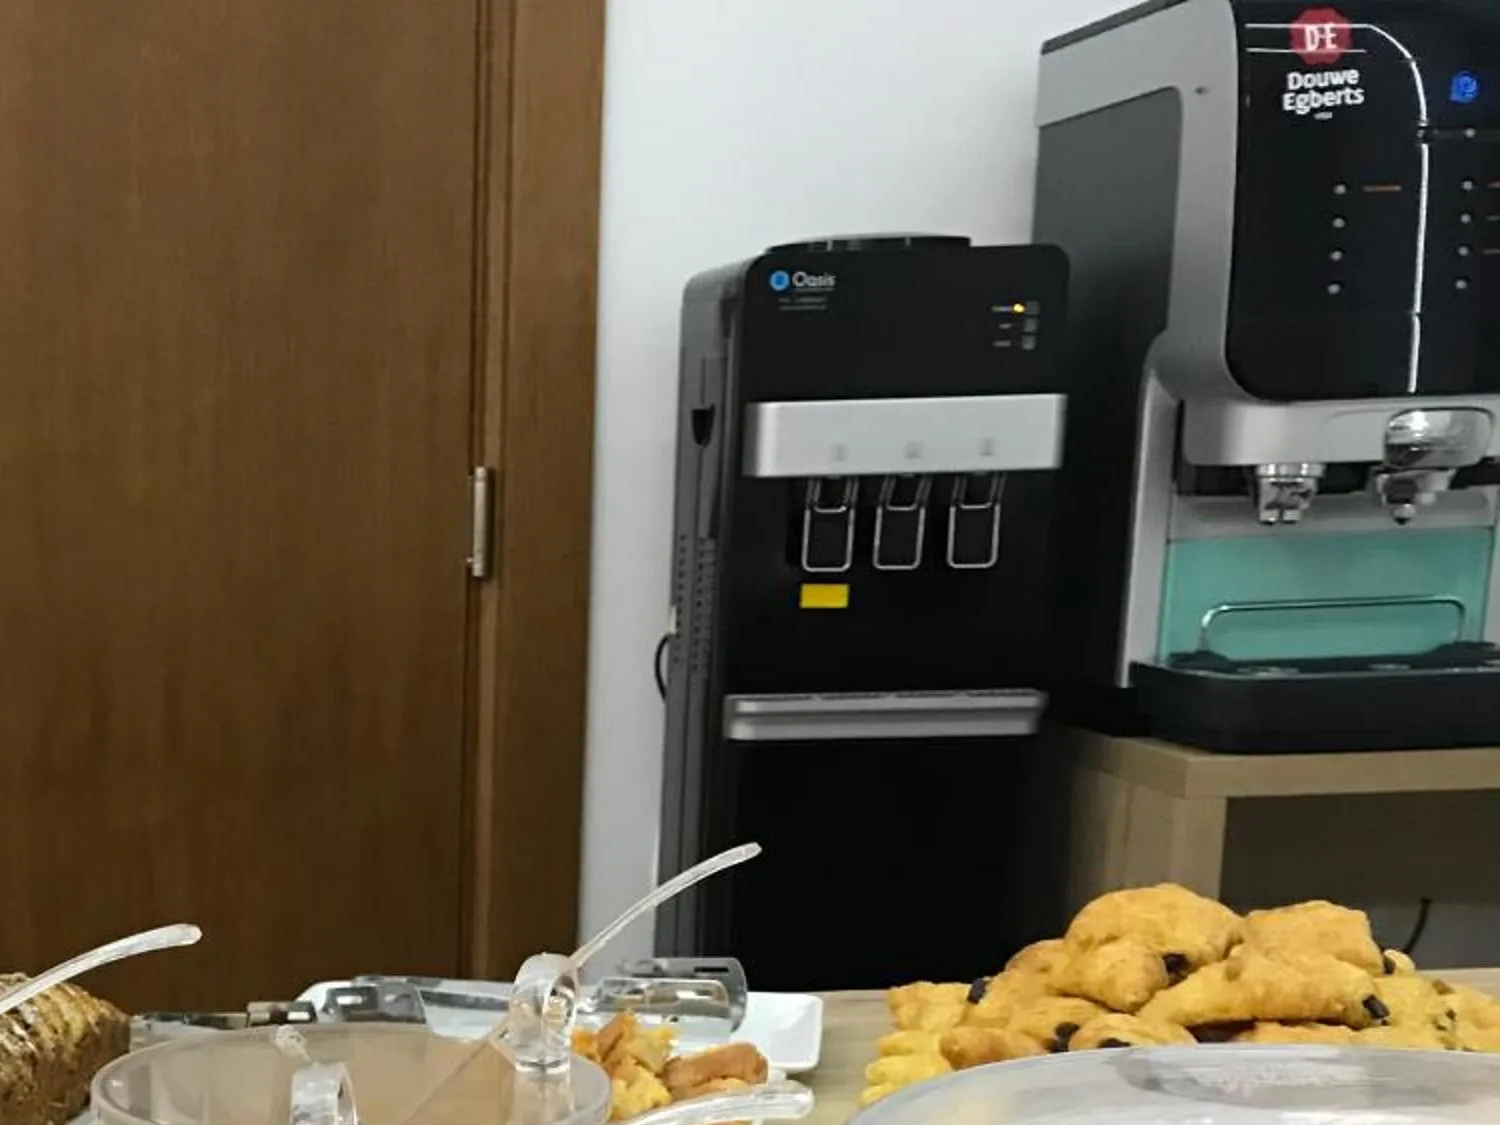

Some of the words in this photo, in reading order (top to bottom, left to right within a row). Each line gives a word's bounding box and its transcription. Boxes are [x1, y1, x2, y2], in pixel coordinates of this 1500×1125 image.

[1287, 69, 1360, 90] Douwe
[1283, 87, 1365, 115] Egberts
[792, 271, 836, 287] Oasis
